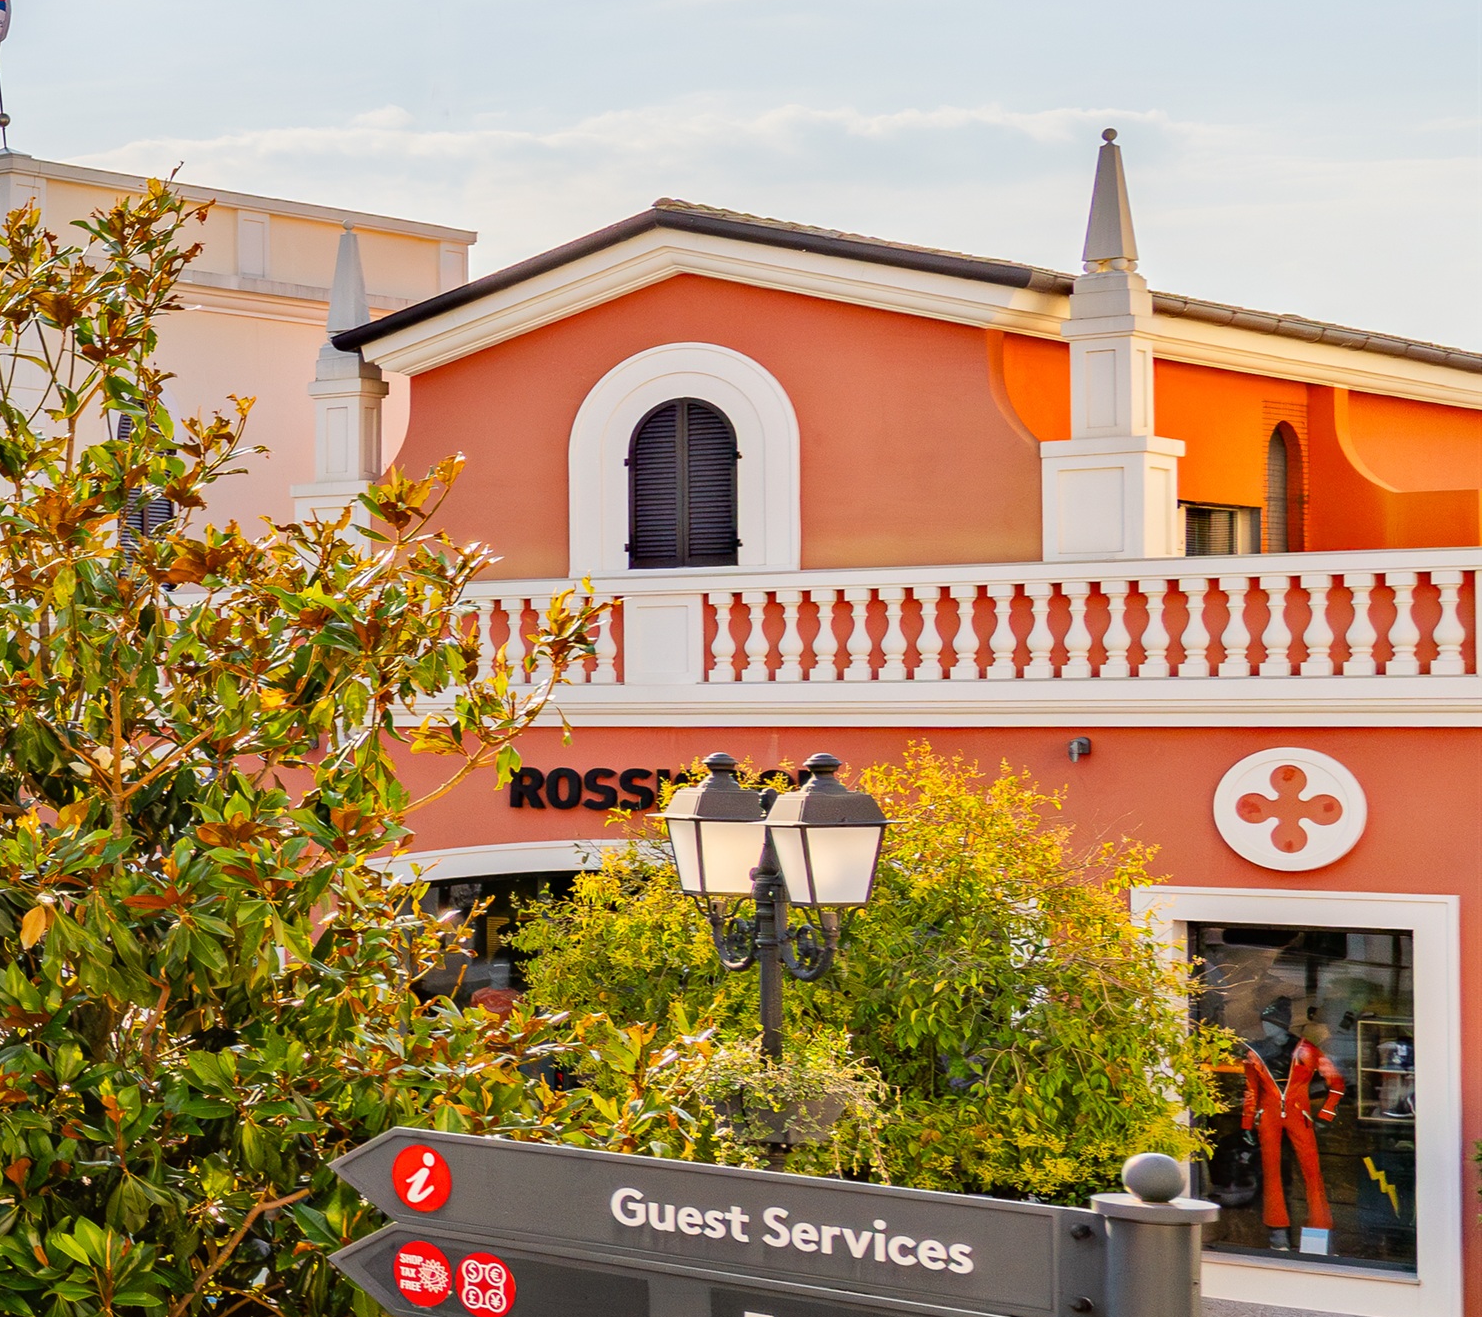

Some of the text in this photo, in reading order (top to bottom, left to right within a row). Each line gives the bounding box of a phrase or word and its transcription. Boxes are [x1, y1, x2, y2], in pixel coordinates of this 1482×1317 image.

[610, 1187, 975, 1275] Guest Services
[399, 1252, 424, 1266] SHOP
[399, 1265, 417, 1278] TAX
[399, 1279, 422, 1293] FREE
